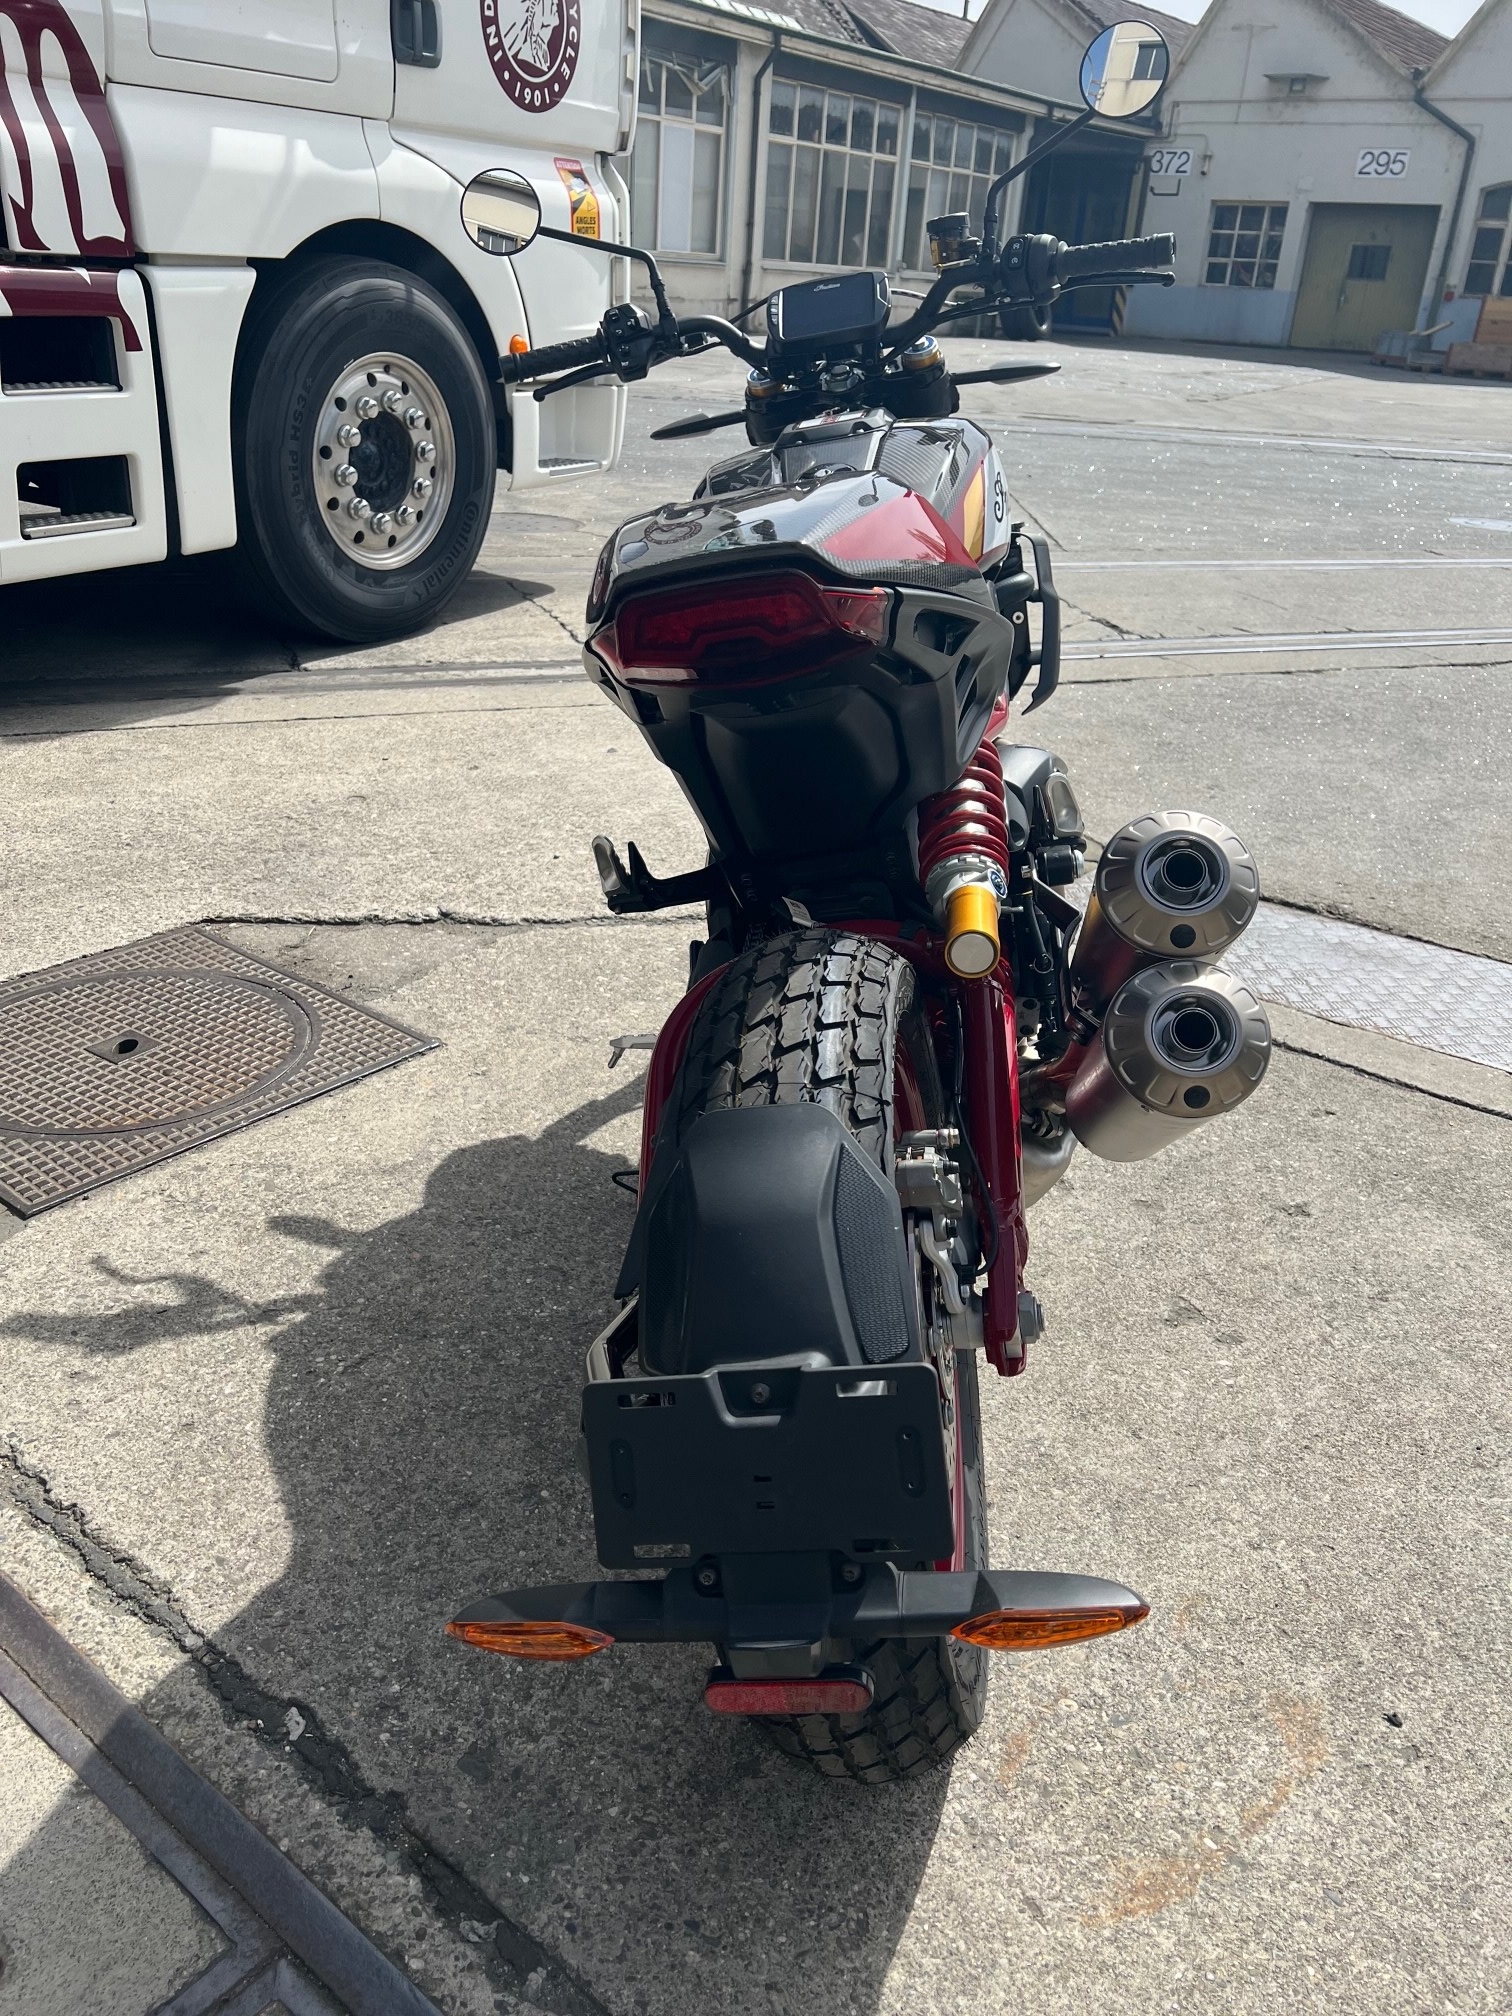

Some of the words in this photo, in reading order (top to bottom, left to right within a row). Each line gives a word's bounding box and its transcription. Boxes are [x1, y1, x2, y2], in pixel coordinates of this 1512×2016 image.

[515, 81, 550, 107] 1901
[1150, 150, 1190, 174] 372
[1358, 151, 1408, 175] 295
[575, 216, 596, 225] ANGLES
[576, 226, 596, 235] MORTS
[422, 501, 479, 596] Continental
